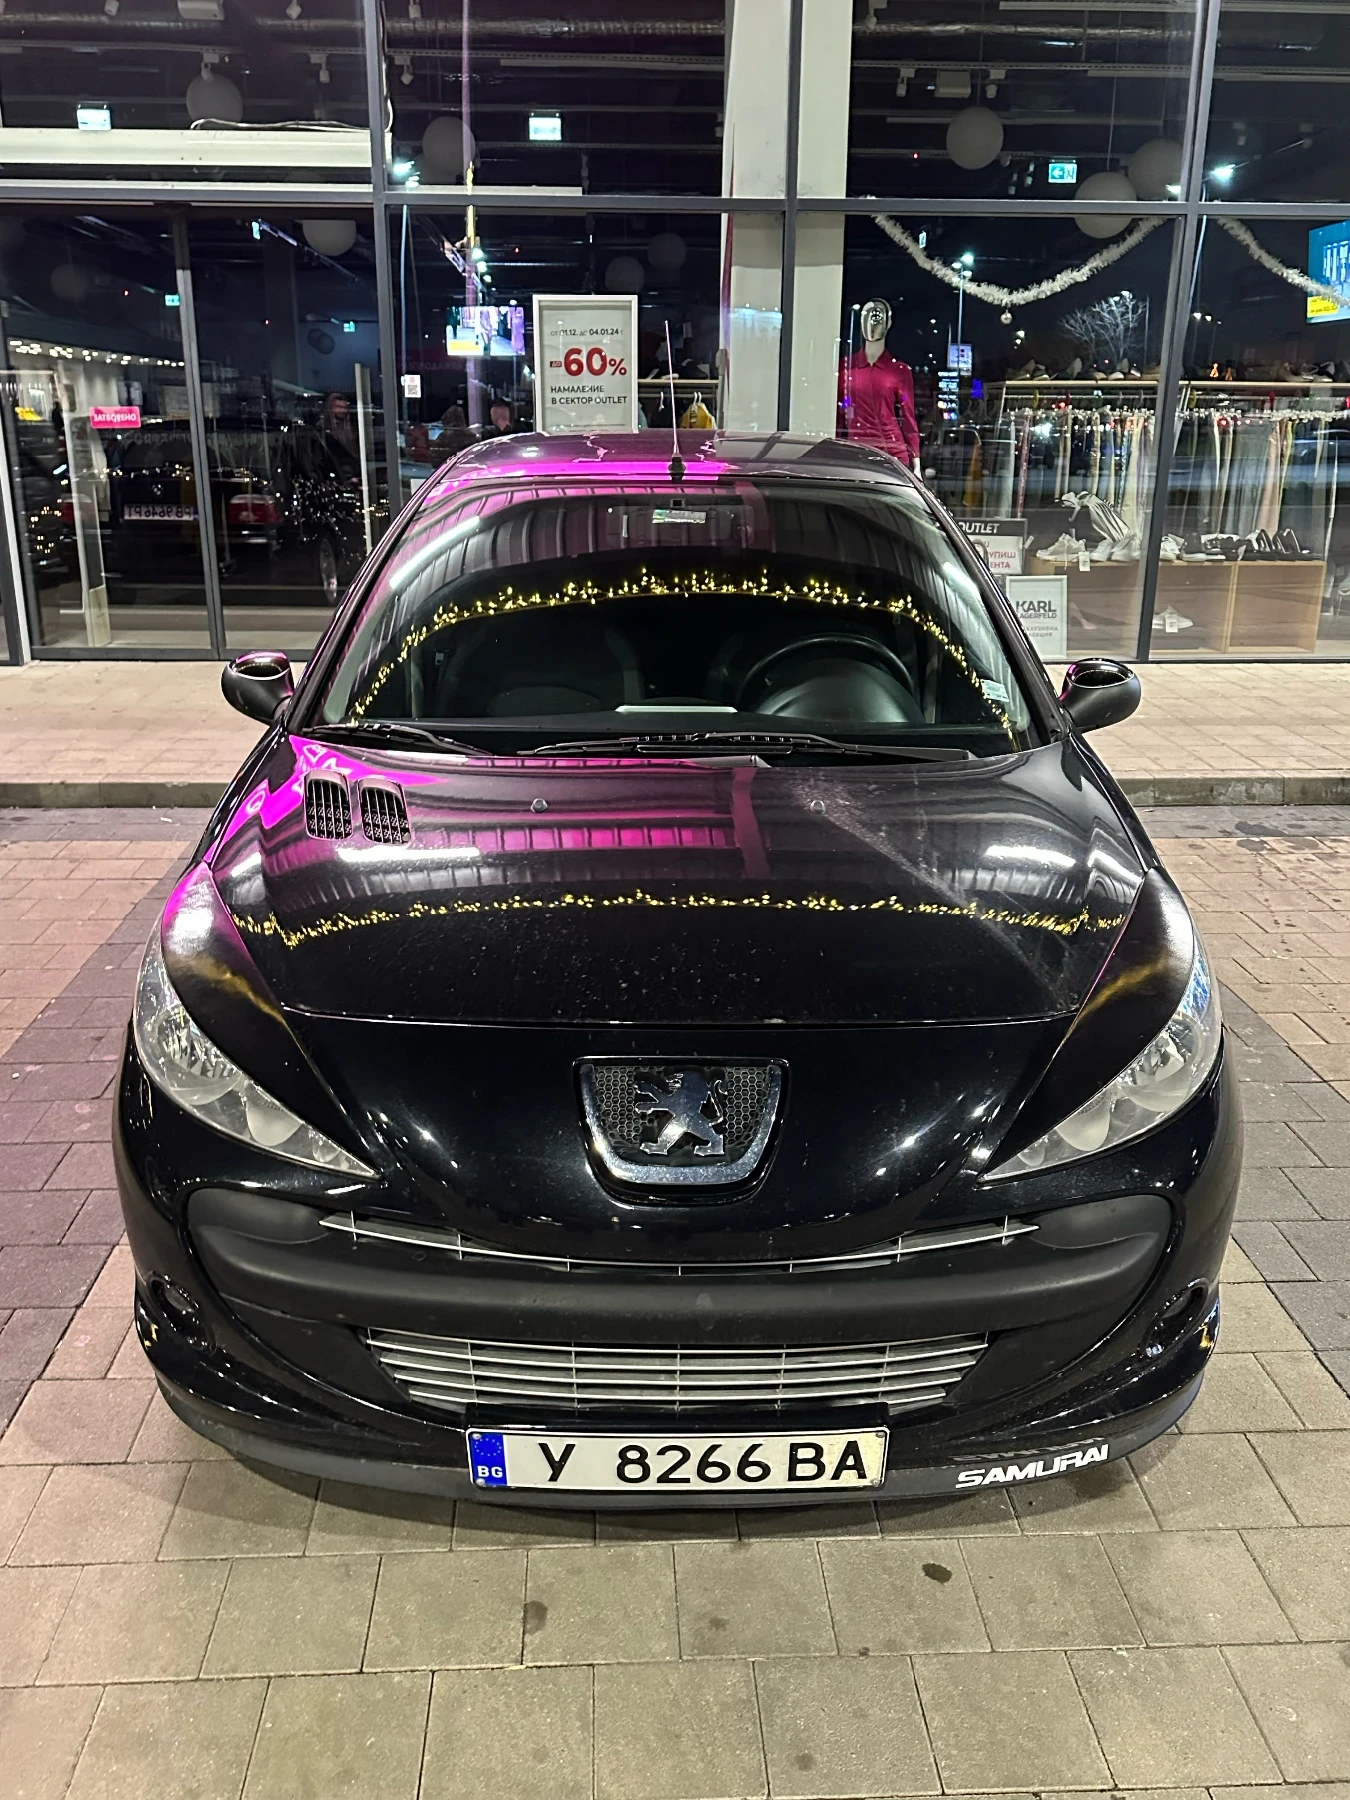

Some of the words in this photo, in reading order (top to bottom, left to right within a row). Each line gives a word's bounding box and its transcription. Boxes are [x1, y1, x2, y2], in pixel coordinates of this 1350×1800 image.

[588, 328, 619, 336] 04.01.24
[564, 347, 627, 376] 60%
[595, 396, 627, 404] OUTLET
[988, 551, 1016, 559] УПИШ
[990, 561, 1011, 569] ЕНТА
[1015, 600, 1057, 613] KARL
[616, 1443, 772, 1484] 8266
[787, 1440, 868, 1482] BA
[955, 1443, 1109, 1489] SAMURAI
[477, 1465, 504, 1479] BG
